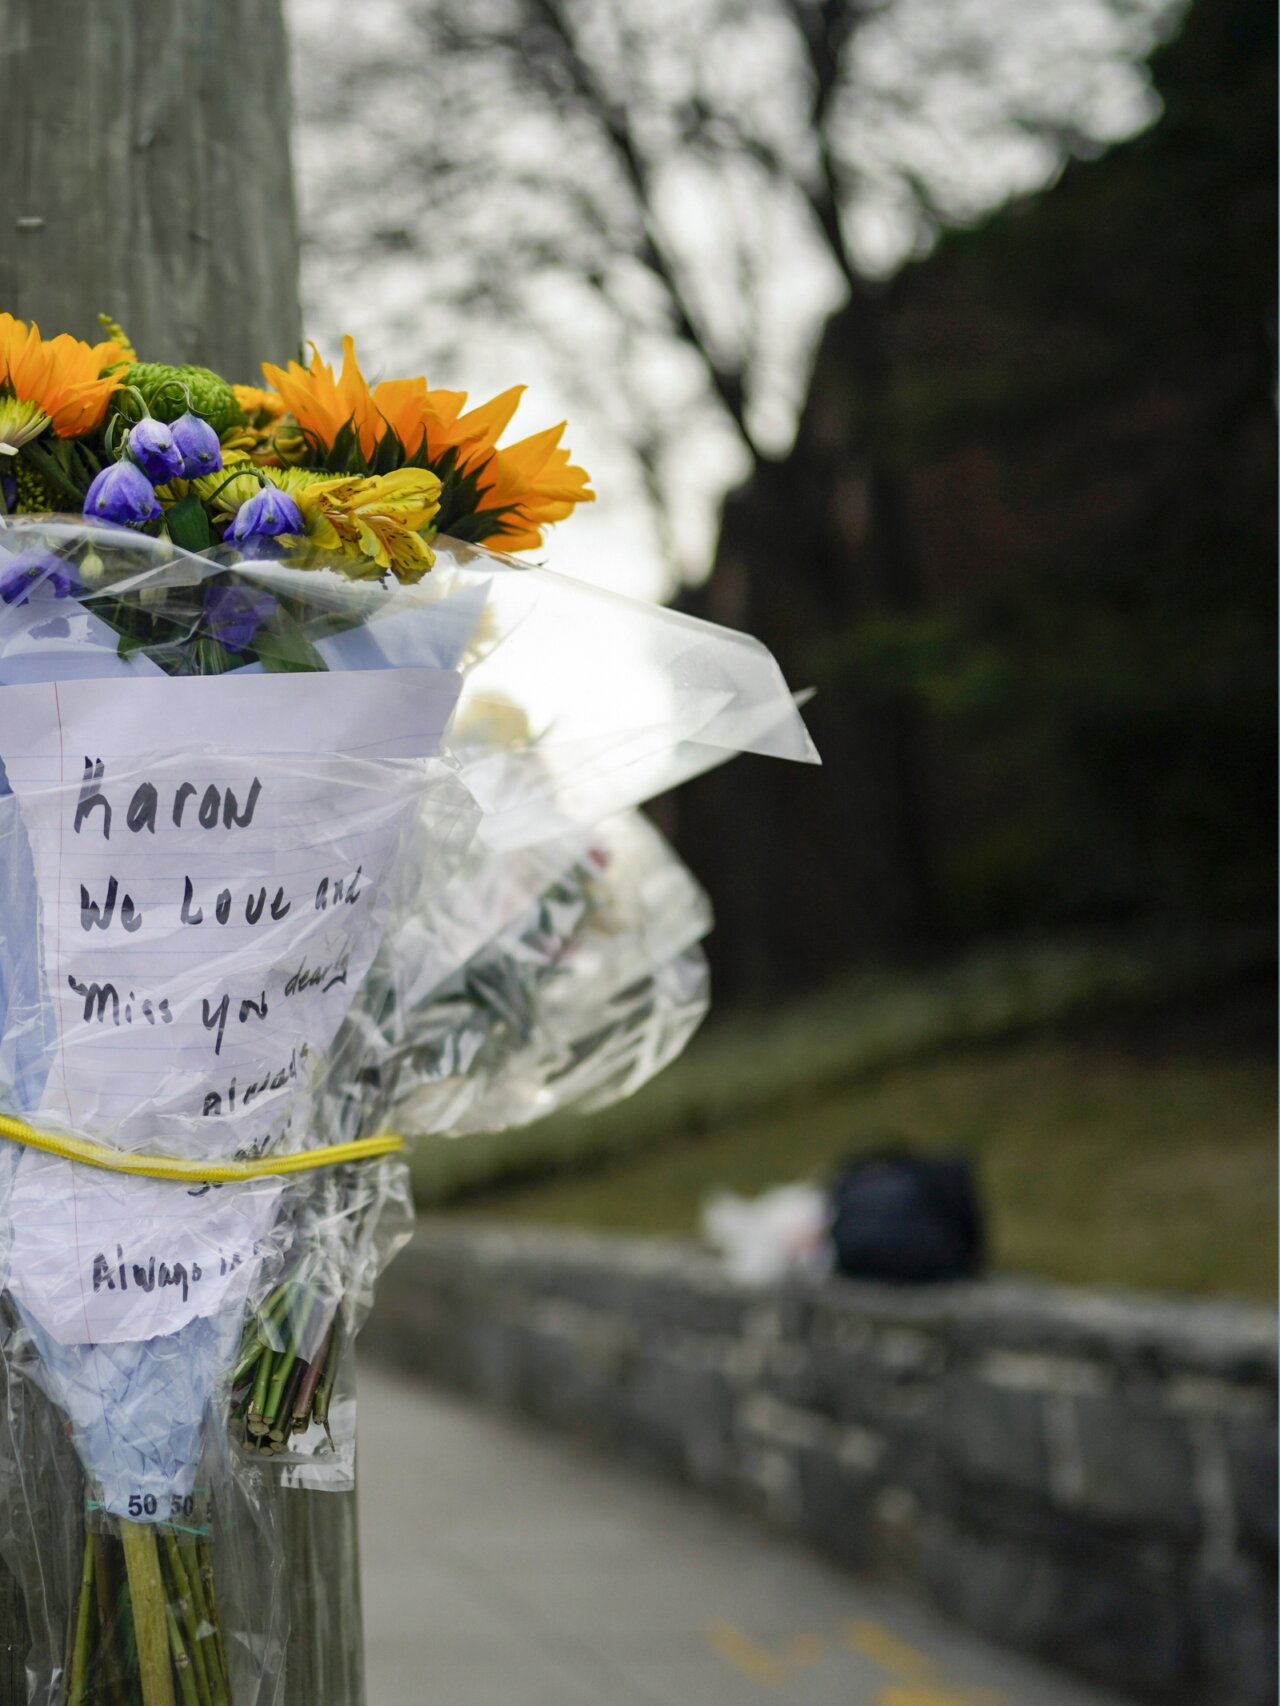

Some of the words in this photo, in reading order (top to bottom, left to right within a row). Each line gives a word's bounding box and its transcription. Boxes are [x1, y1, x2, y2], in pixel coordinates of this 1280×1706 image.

[80, 875, 142, 932] We
[180, 875, 291, 925] Love
[128, 1494, 157, 1517] 50
[171, 1494, 194, 1517] 50
